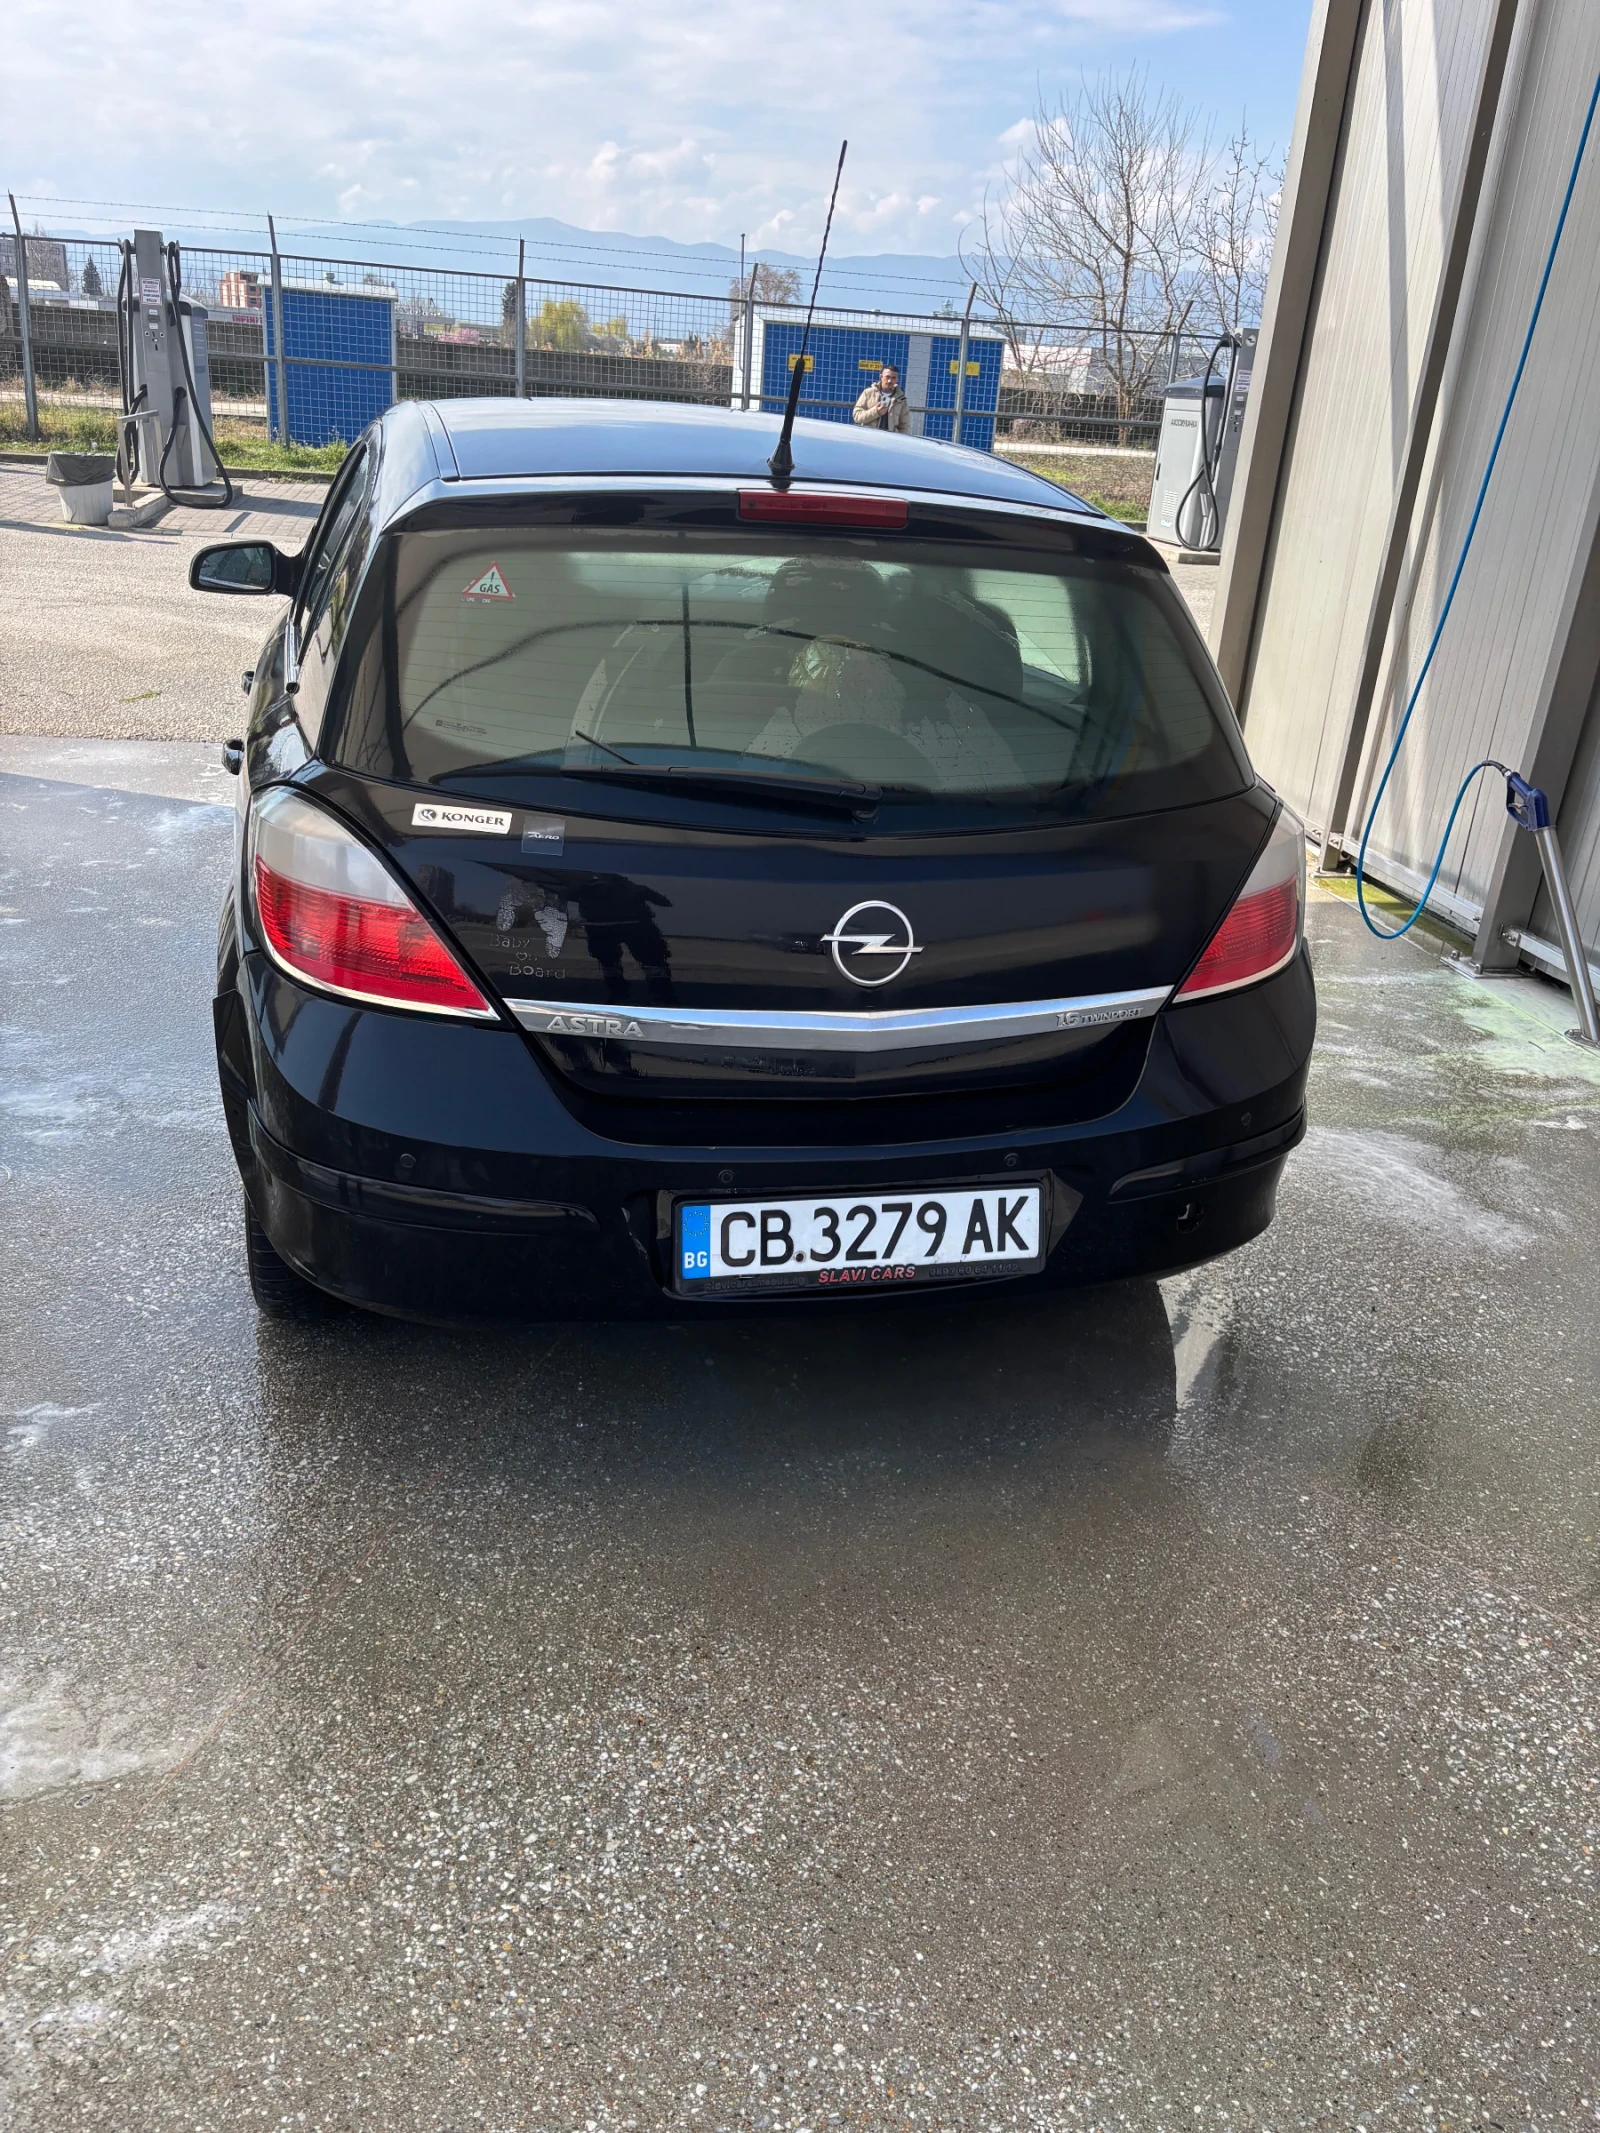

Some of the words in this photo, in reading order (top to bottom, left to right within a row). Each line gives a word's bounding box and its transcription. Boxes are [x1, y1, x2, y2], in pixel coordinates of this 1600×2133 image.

[479, 583, 501, 594] GAS
[441, 811, 505, 826] KONGER
[489, 933, 531, 948] Baby
[509, 964, 566, 980] Board
[1081, 1007, 1143, 1023] TWINPORT
[546, 1016, 645, 1038] ASTRA
[809, 1201, 948, 1264] 3279
[961, 1195, 1030, 1255] AK
[683, 1251, 708, 1270] BG
[817, 1266, 866, 1284] SLAVI
[869, 1265, 916, 1280] CARS
